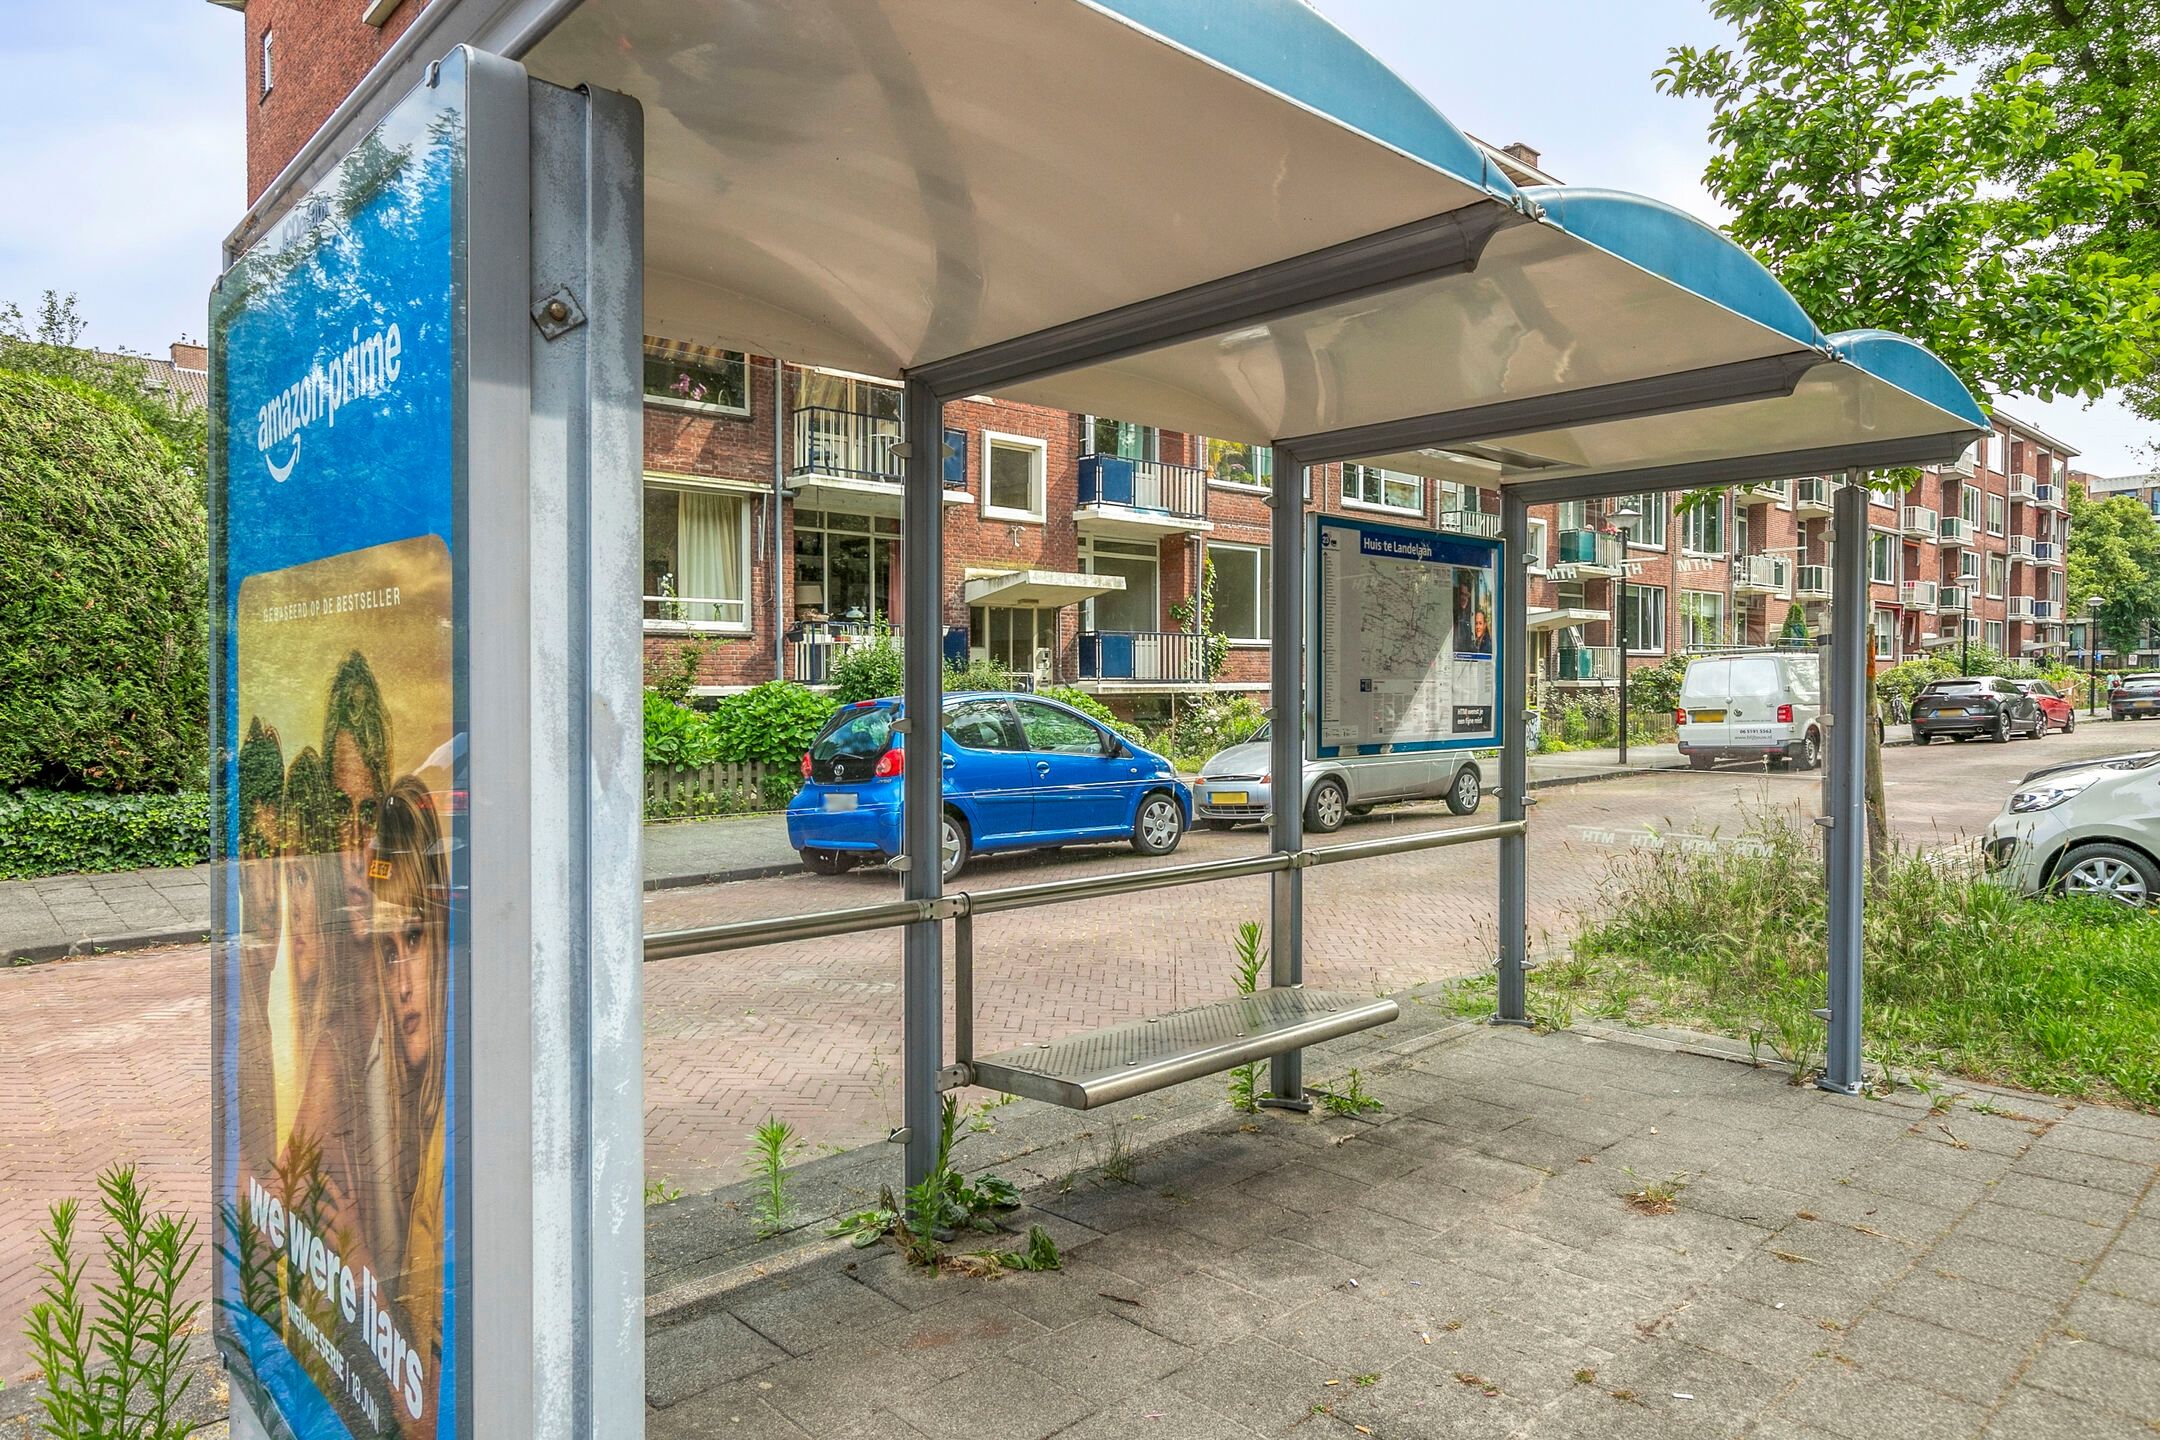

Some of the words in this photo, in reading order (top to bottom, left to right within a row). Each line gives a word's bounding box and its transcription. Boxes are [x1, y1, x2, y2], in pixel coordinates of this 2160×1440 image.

[258, 366, 326, 452] amazon
[328, 322, 401, 427] prime
[1363, 537, 1382, 551] Huis
[1383, 541, 1392, 552] te
[263, 602, 308, 622] GEBASEERD
[310, 600, 320, 616] OP
[323, 597, 333, 615] DE
[336, 587, 400, 613] BESTSELLER
[1582, 830, 1615, 844] HTM
[250, 1176, 285, 1248] we
[289, 1211, 357, 1324] were
[362, 1265, 423, 1420] liars
[287, 1296, 319, 1352] NIEUWE
[319, 1332, 344, 1381] SERIE
[351, 1371, 361, 1403] 18
[361, 1387, 379, 1434] JUNI
